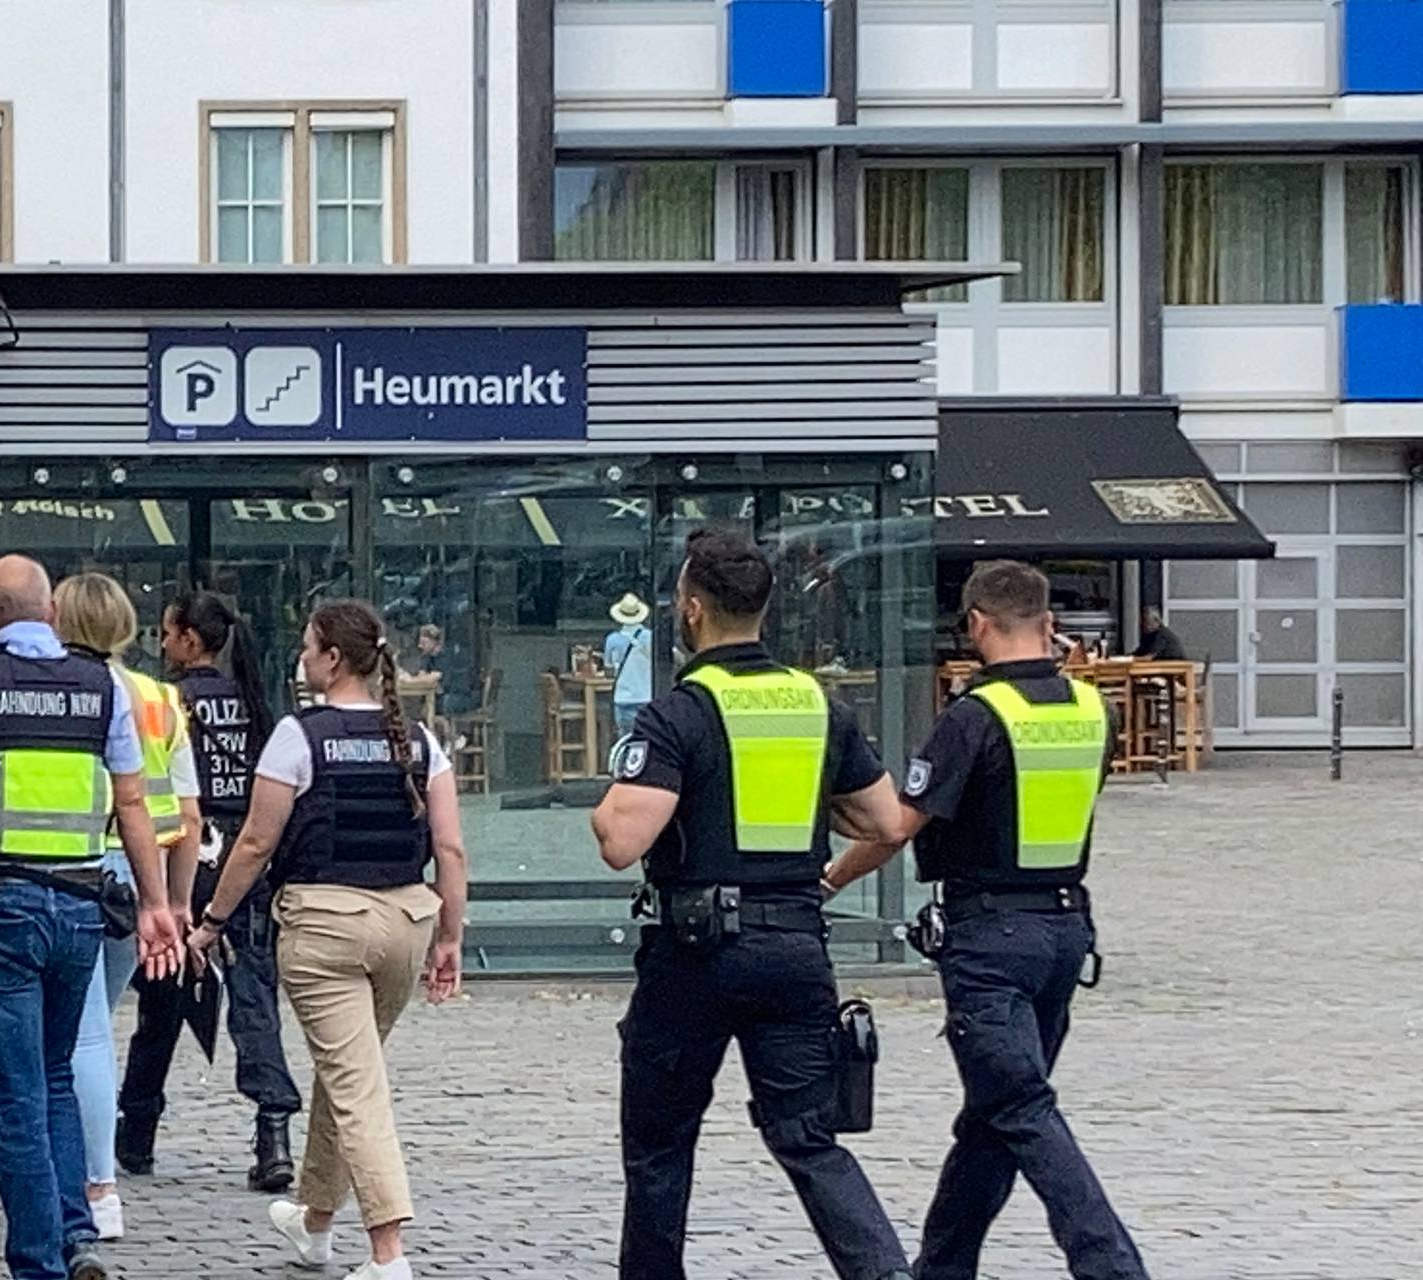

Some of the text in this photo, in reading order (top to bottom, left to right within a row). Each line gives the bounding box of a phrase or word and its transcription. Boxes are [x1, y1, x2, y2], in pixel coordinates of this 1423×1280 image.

[353, 364, 566, 405] Heumarkt
[70, 692, 102, 717] NRW
[212, 775, 247, 797] BAT
